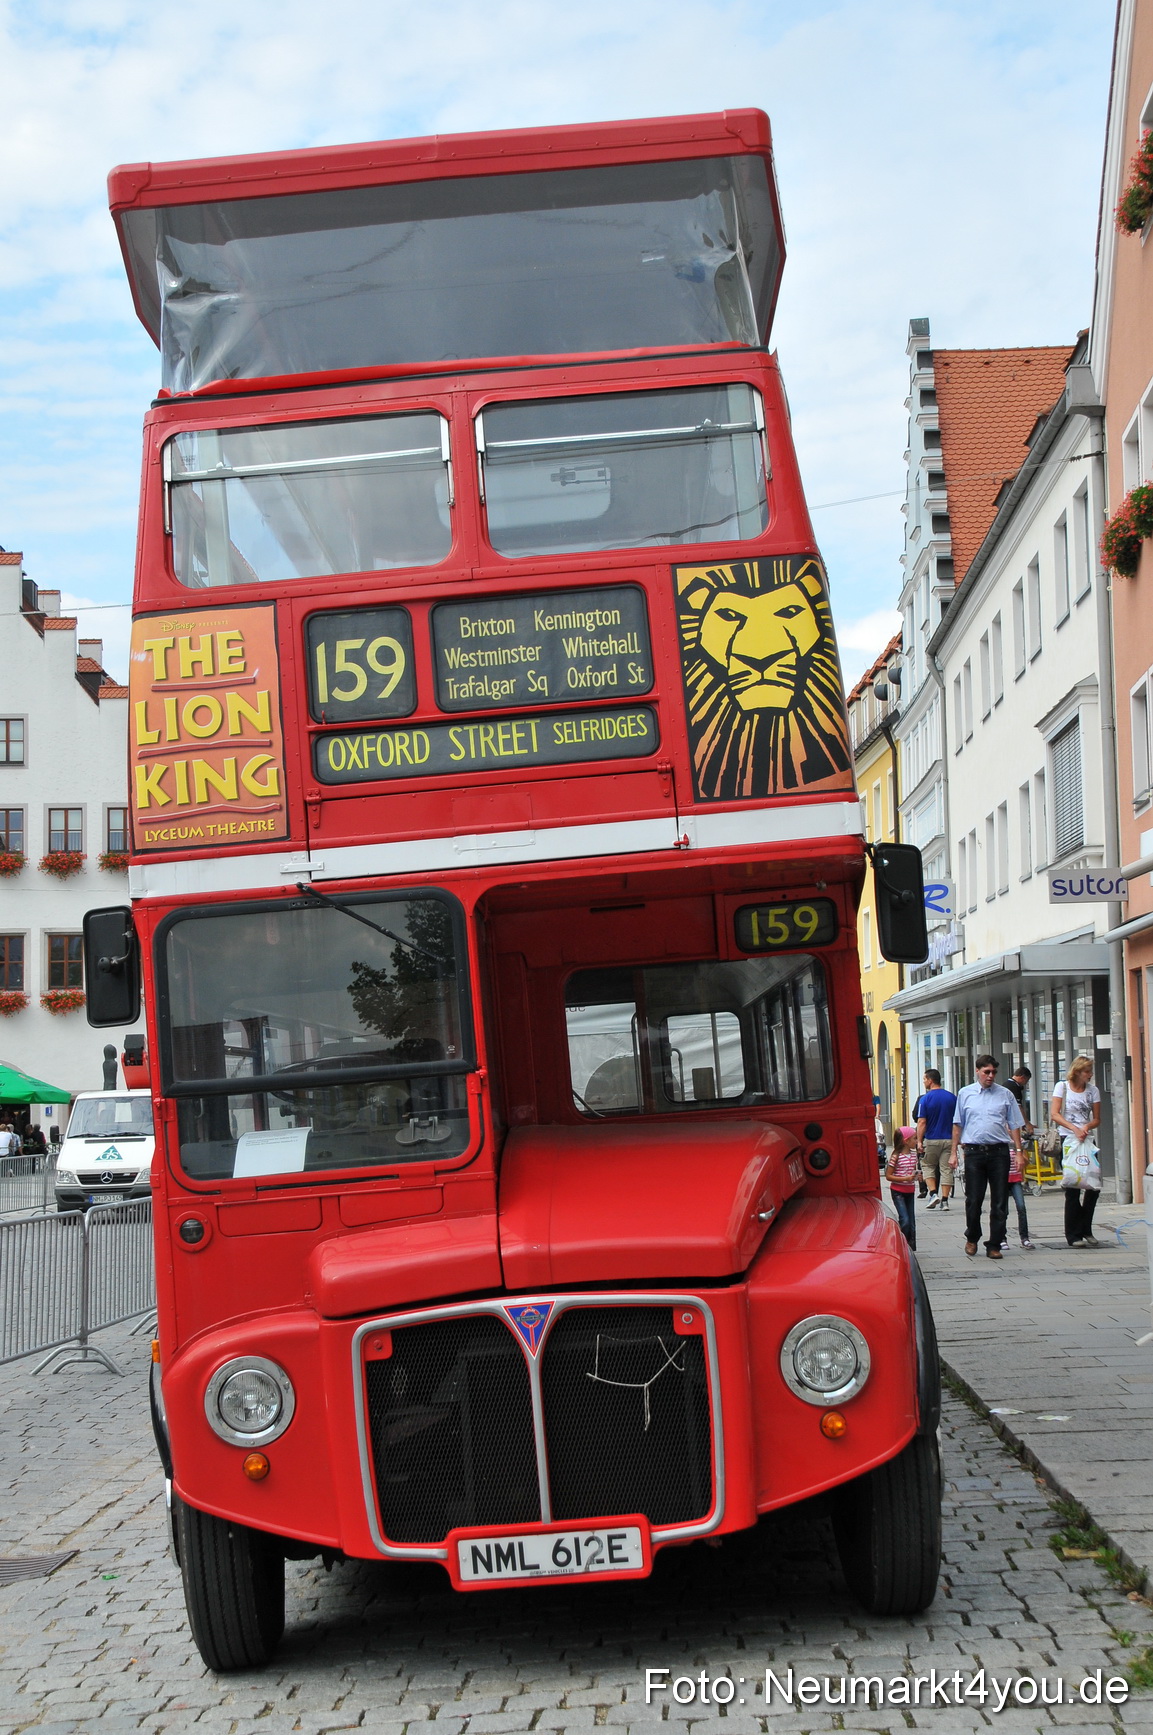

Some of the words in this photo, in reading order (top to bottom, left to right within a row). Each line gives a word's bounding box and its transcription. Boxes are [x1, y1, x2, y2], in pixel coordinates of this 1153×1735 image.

[459, 616, 516, 639] Brixton
[533, 608, 621, 632] Kennington
[144, 629, 246, 681] THE
[316, 636, 406, 704] 159
[444, 645, 542, 670] Westminster
[562, 632, 642, 659] Whitehall
[446, 676, 517, 701] Trafalgar
[527, 670, 549, 697] Sq
[566, 664, 618, 690] Oxford
[627, 662, 646, 685] St
[134, 690, 272, 746] LION
[327, 730, 431, 772] OXFORD
[448, 719, 541, 761] STREET
[552, 713, 648, 745] SELFRIDGES
[134, 754, 280, 809] KING
[145, 826, 205, 842] LYCEUM
[206, 818, 275, 837] THEATRE
[751, 906, 820, 946] 159
[470, 1541, 541, 1575] NML
[551, 1533, 630, 1568] 612E
